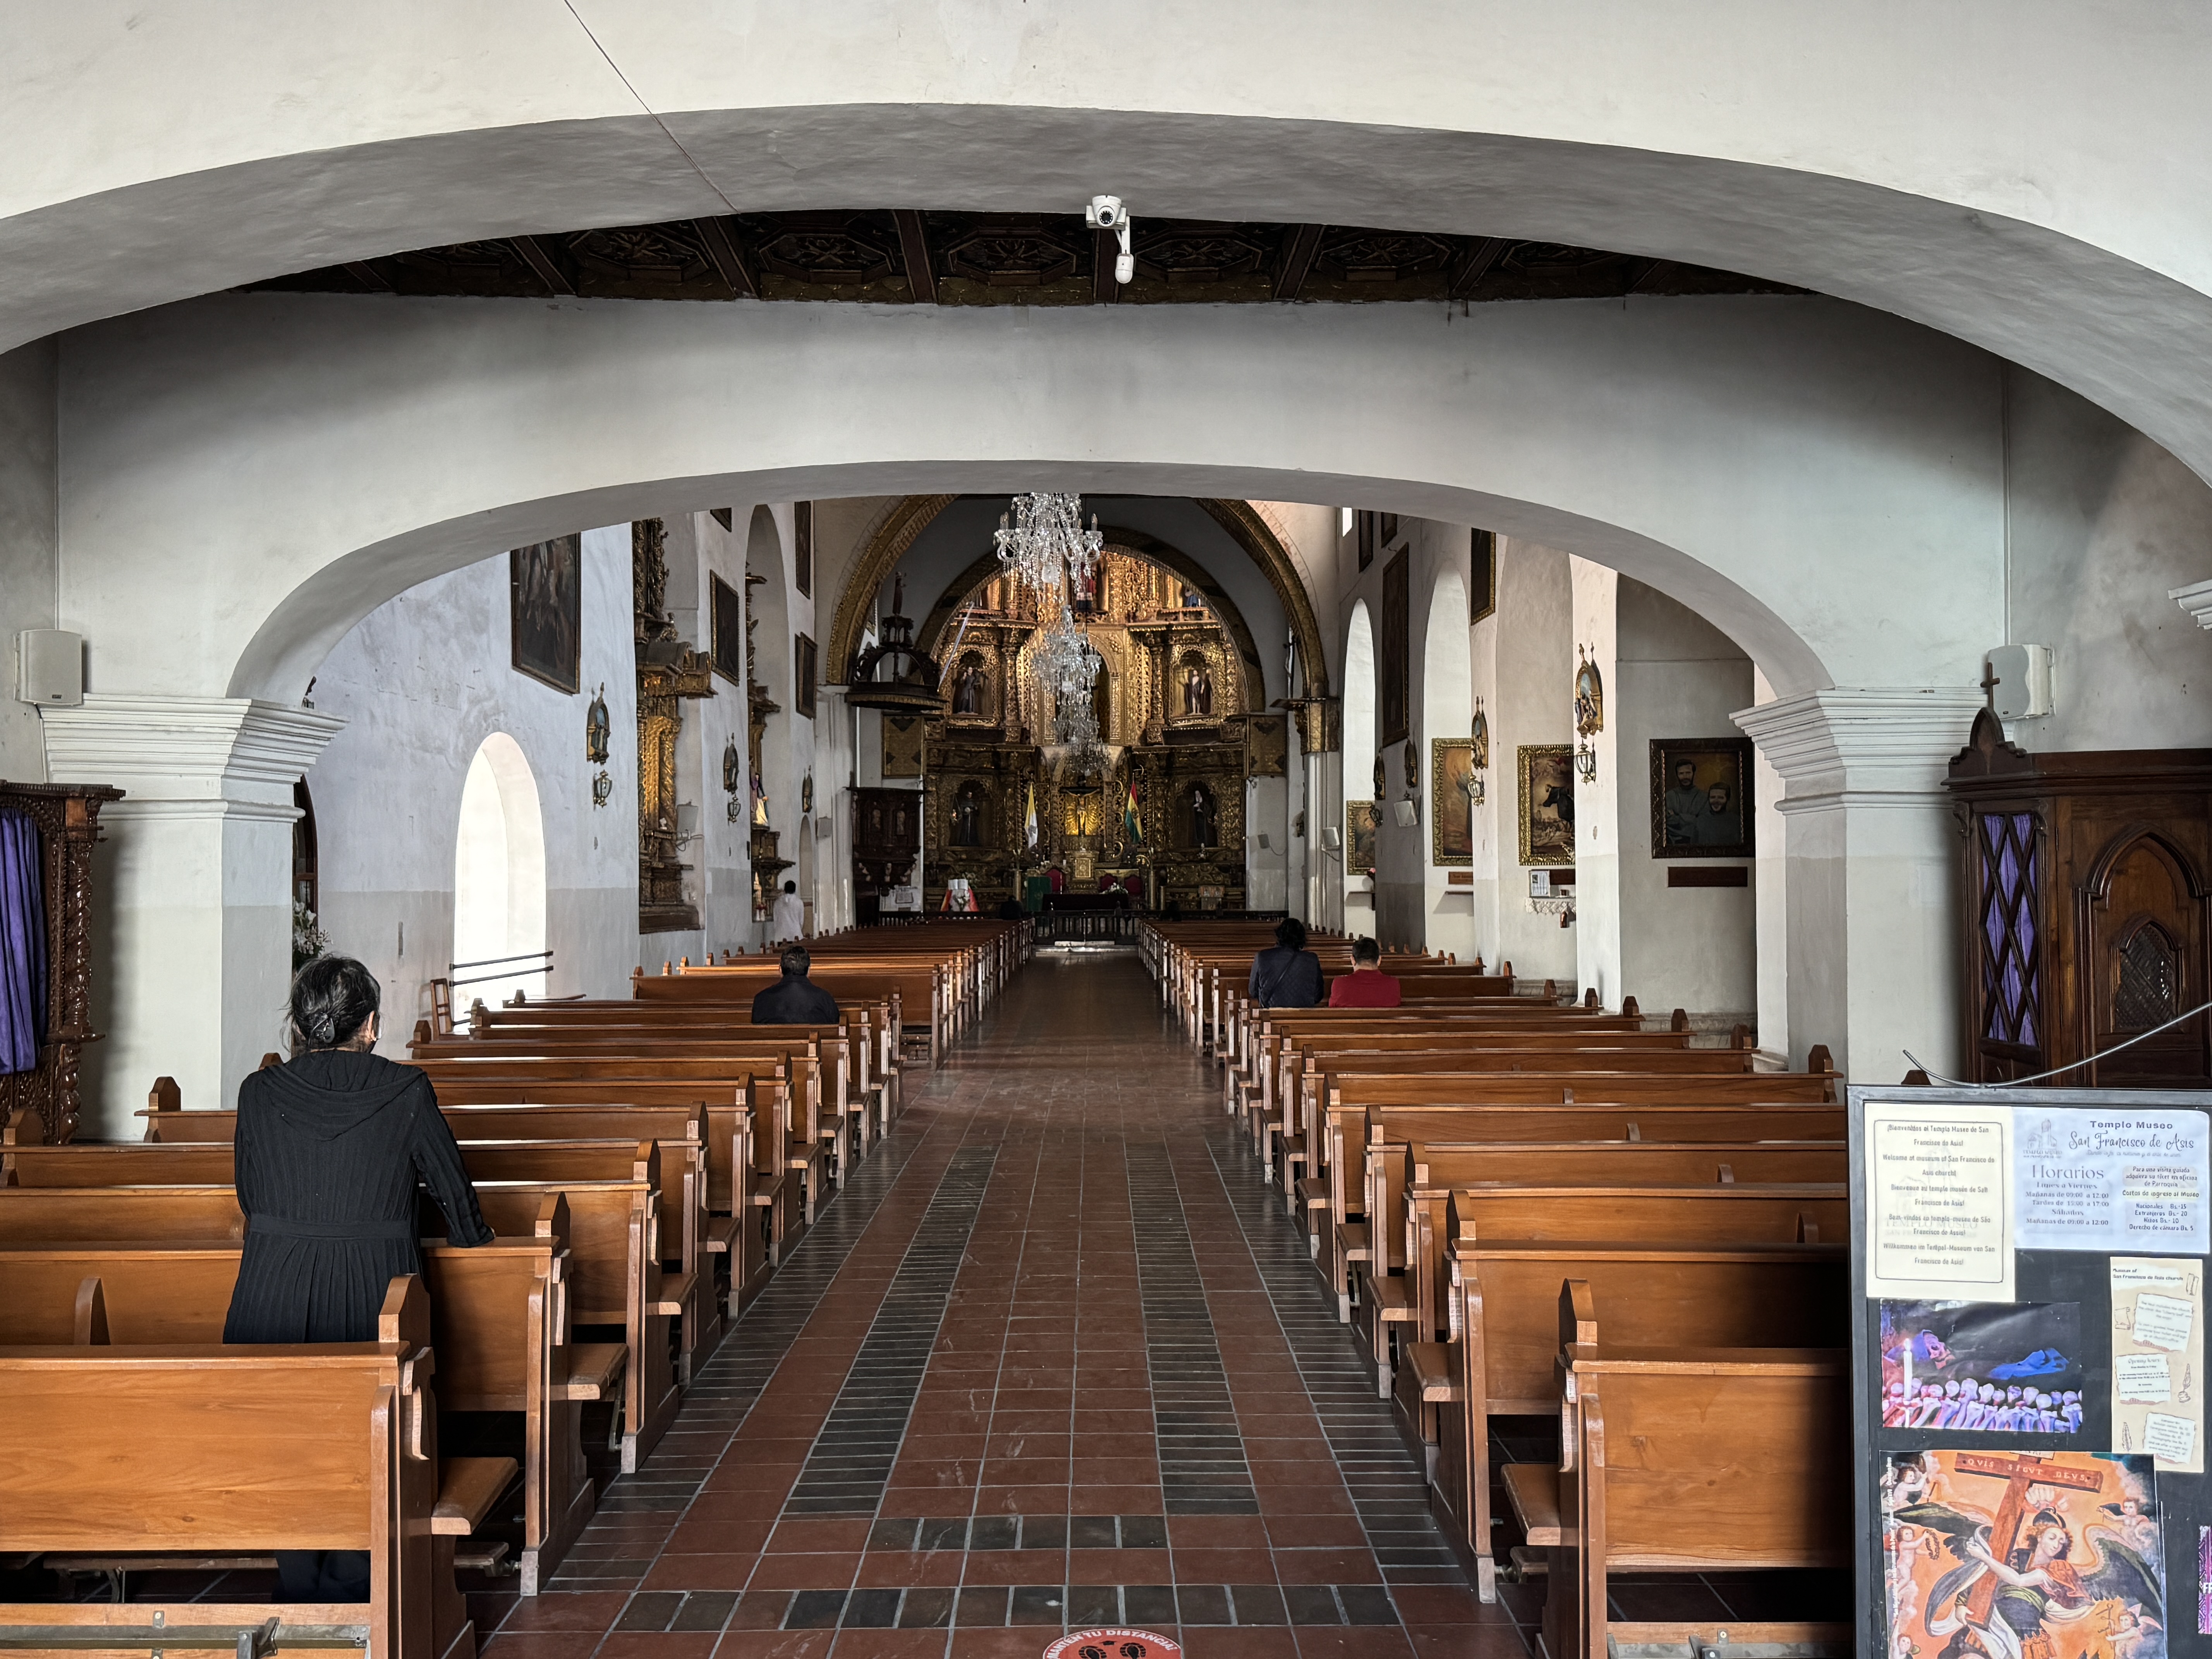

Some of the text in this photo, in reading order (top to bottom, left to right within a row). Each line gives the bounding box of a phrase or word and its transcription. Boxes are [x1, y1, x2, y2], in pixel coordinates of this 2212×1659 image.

[2090, 1121, 2131, 1130] Templo
[2069, 1130, 2090, 1149] San
[2095, 1130, 2145, 1150] Francisco
[2149, 1134, 2161, 1147] de
[2033, 1165, 2104, 1179] Horarios
